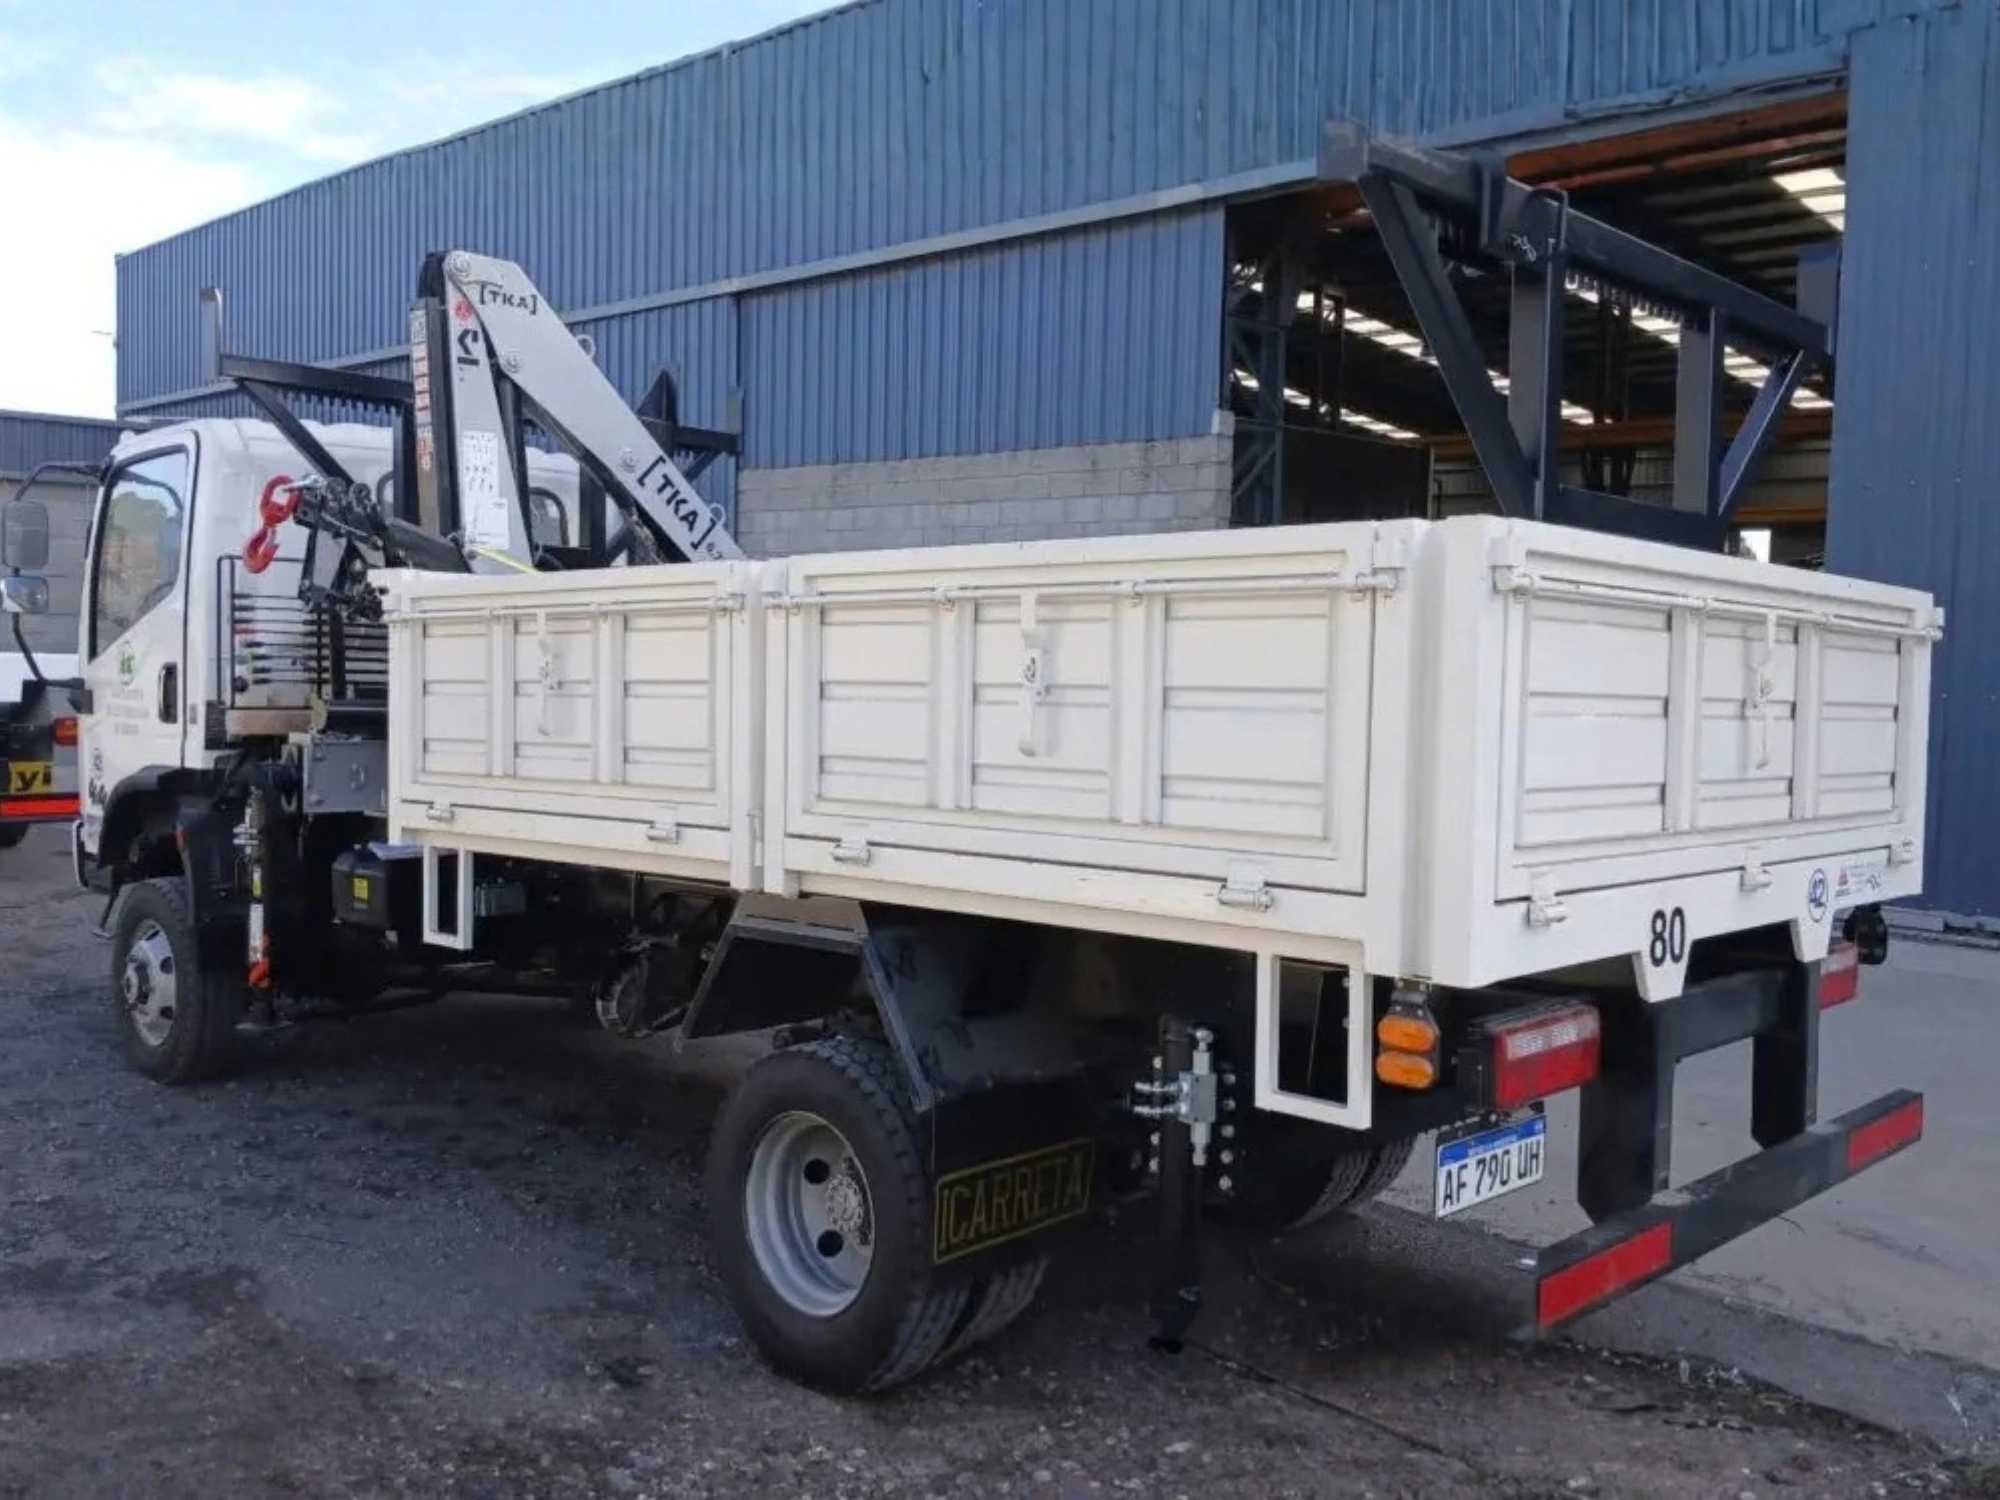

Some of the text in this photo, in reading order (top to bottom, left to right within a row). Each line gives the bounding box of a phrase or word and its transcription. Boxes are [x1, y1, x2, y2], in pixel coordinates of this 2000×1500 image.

[1650, 906, 1686, 968] 80
[1443, 1163, 1468, 1209] AF
[1475, 1149, 1510, 1197] 790
[1517, 1139, 1541, 1180] UH
